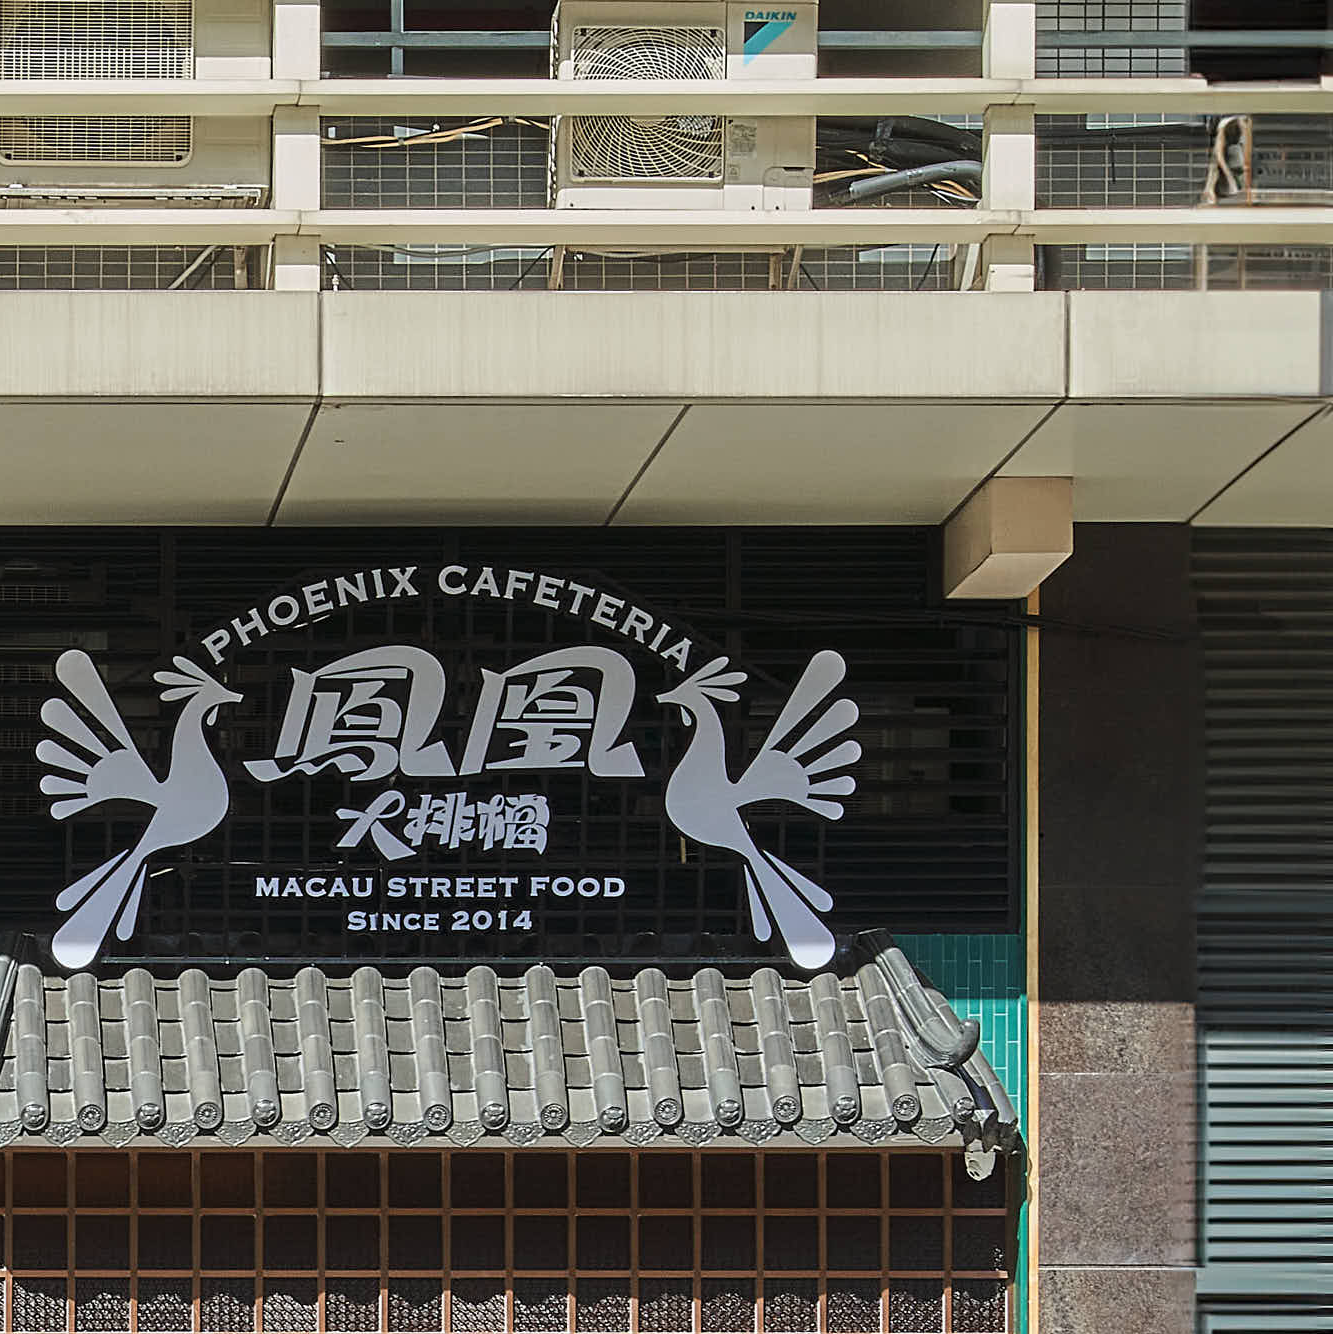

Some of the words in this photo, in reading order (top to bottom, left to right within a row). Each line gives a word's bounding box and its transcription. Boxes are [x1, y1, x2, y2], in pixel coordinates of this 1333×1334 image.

[744, 11, 797, 20] DAIKIN
[201, 566, 419, 665] PHOENIX
[438, 564, 694, 672] CAFETERIA
[243, 645, 645, 782] 鳳凰
[255, 876, 373, 897] MACAU
[387, 876, 518, 898] STREET
[530, 876, 626, 897] FOOD
[451, 910, 532, 931] 2014
